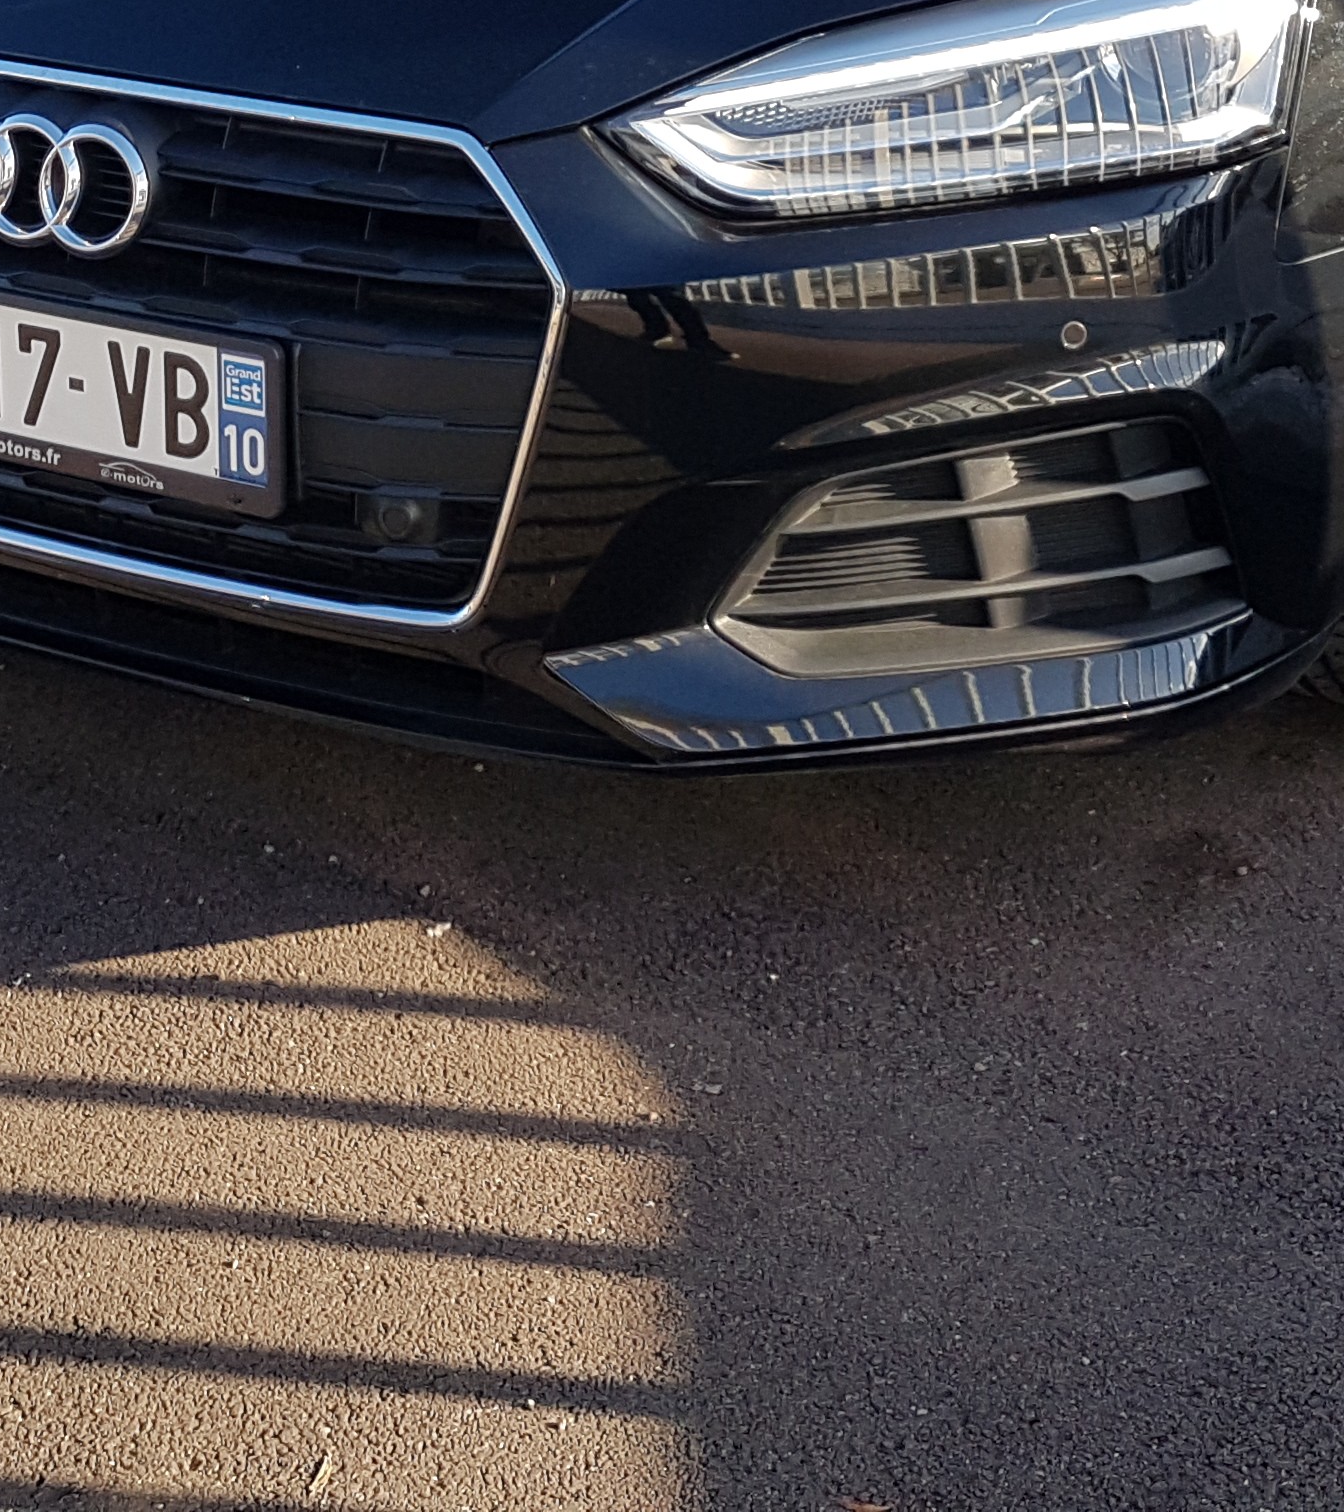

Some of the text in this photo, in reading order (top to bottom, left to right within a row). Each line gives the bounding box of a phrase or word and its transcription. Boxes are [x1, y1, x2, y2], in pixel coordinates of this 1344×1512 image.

[225, 364, 263, 382] Grand
[225, 377, 264, 405] Est
[223, 423, 266, 477] 10
[99, 466, 166, 492] e-motors
